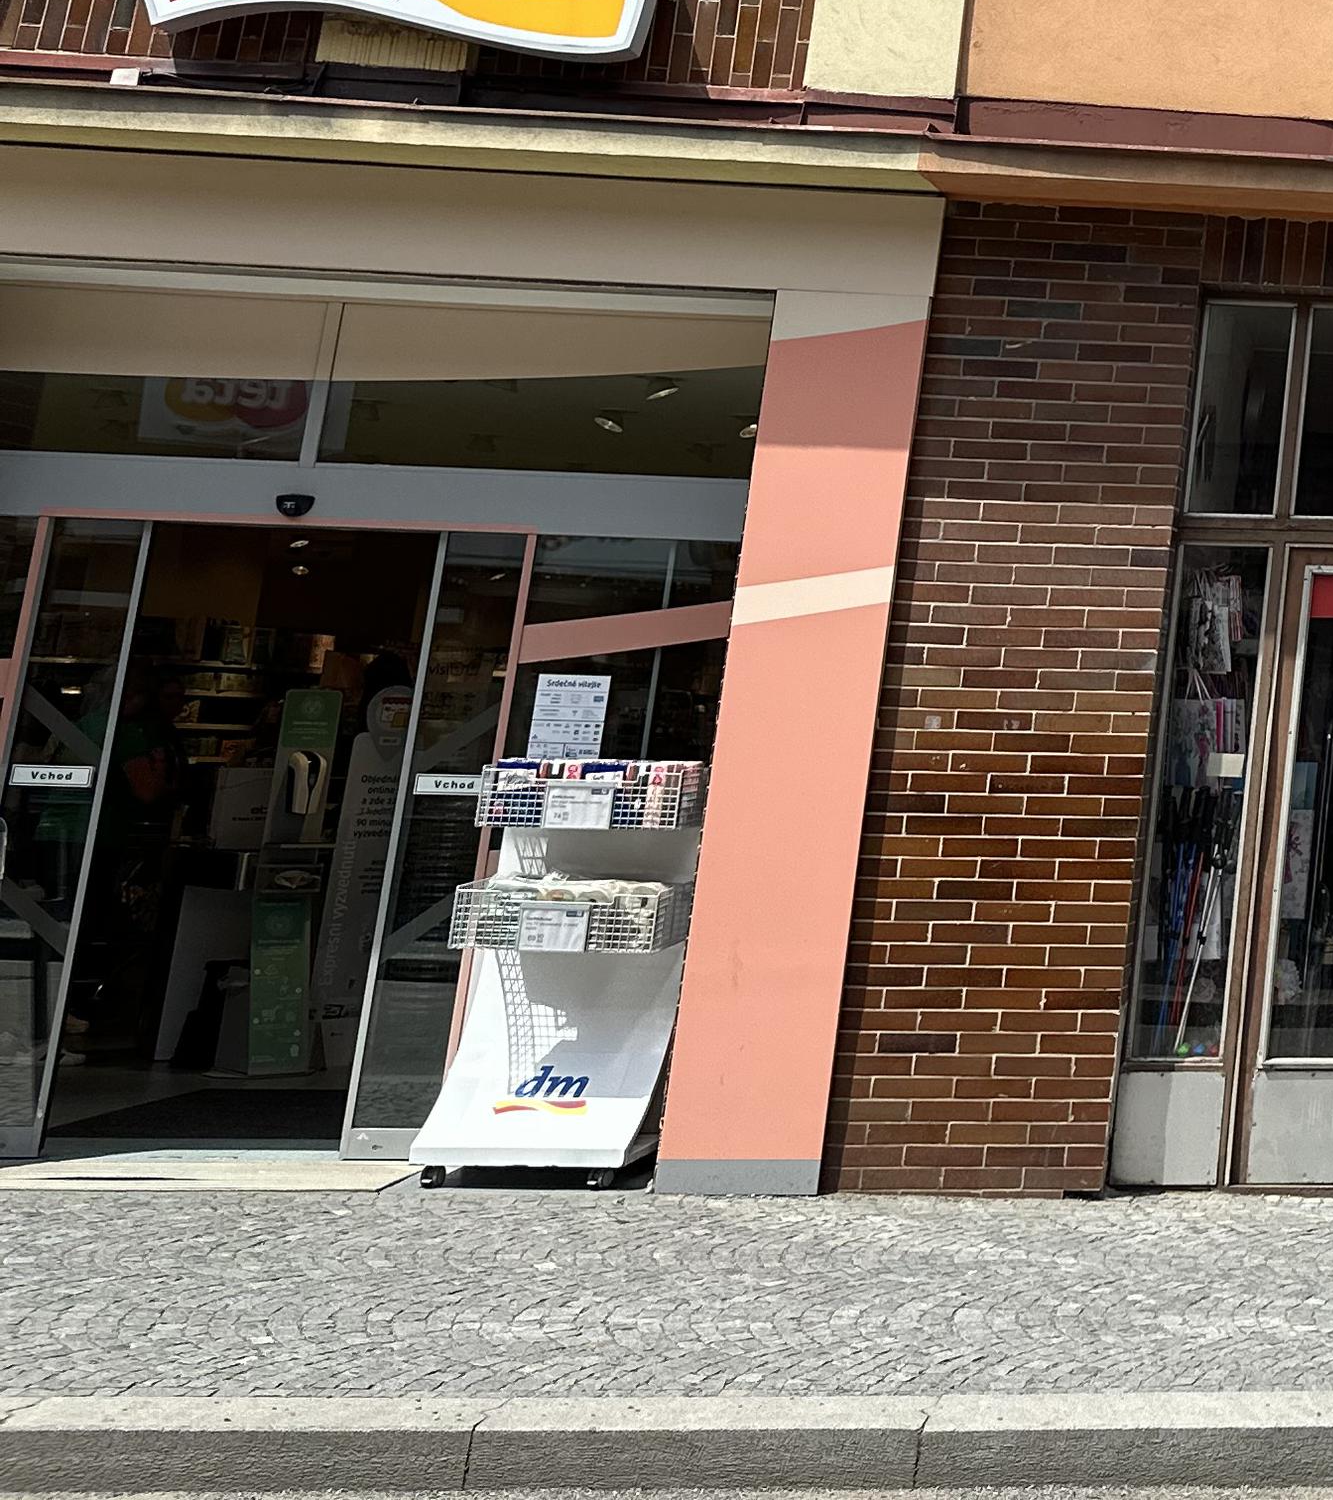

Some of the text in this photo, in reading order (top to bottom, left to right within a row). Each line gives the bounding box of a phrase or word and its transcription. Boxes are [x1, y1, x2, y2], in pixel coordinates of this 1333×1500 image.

[31, 771, 73, 781] Vchod
[434, 780, 474, 789] Vchod
[515, 1065, 590, 1098] dm
